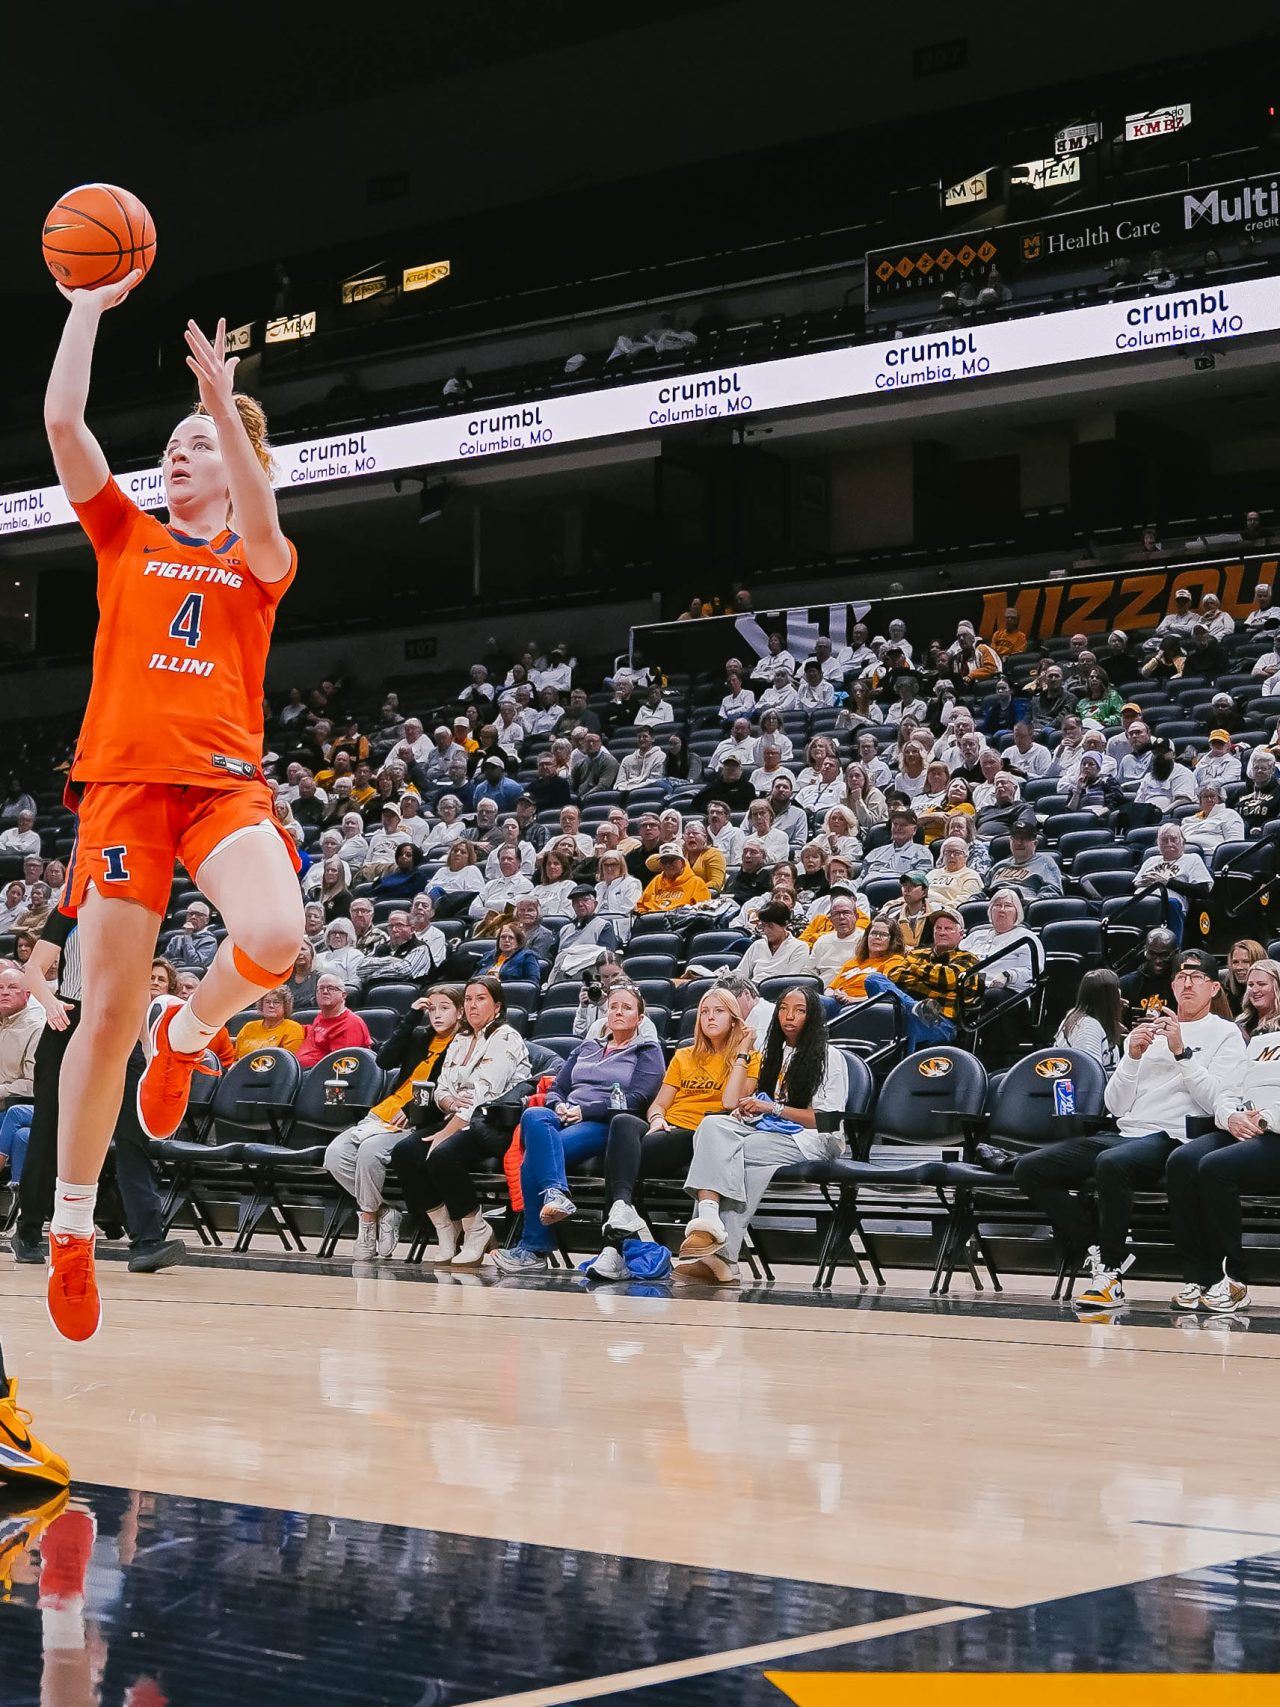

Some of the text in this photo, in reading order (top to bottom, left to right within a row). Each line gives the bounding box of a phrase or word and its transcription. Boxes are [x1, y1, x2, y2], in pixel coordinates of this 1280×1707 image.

[1048, 226, 1109, 254] Health
[1116, 221, 1161, 240] Care
[1127, 290, 1229, 325] crumbl
[1115, 315, 1242, 350] Columbia, MO
[886, 333, 977, 366] crumbl
[875, 357, 989, 388] Columbia, MO
[659, 373, 740, 403] crumbl
[468, 407, 542, 436] crumbl
[649, 396, 752, 425] Columbia, MO
[299, 436, 366, 463] crumbl
[459, 429, 552, 456] Columbia, MO
[290, 457, 375, 482] Columbia, MO
[35, 512, 51, 523] MO
[143, 561, 243, 589] FIGHTING
[979, 561, 1279, 640] MIZZOU
[169, 592, 204, 648] 4
[148, 654, 215, 677] ILLINI
[101, 845, 131, 881] I
[680, 1079, 724, 1091] MIZZOU
